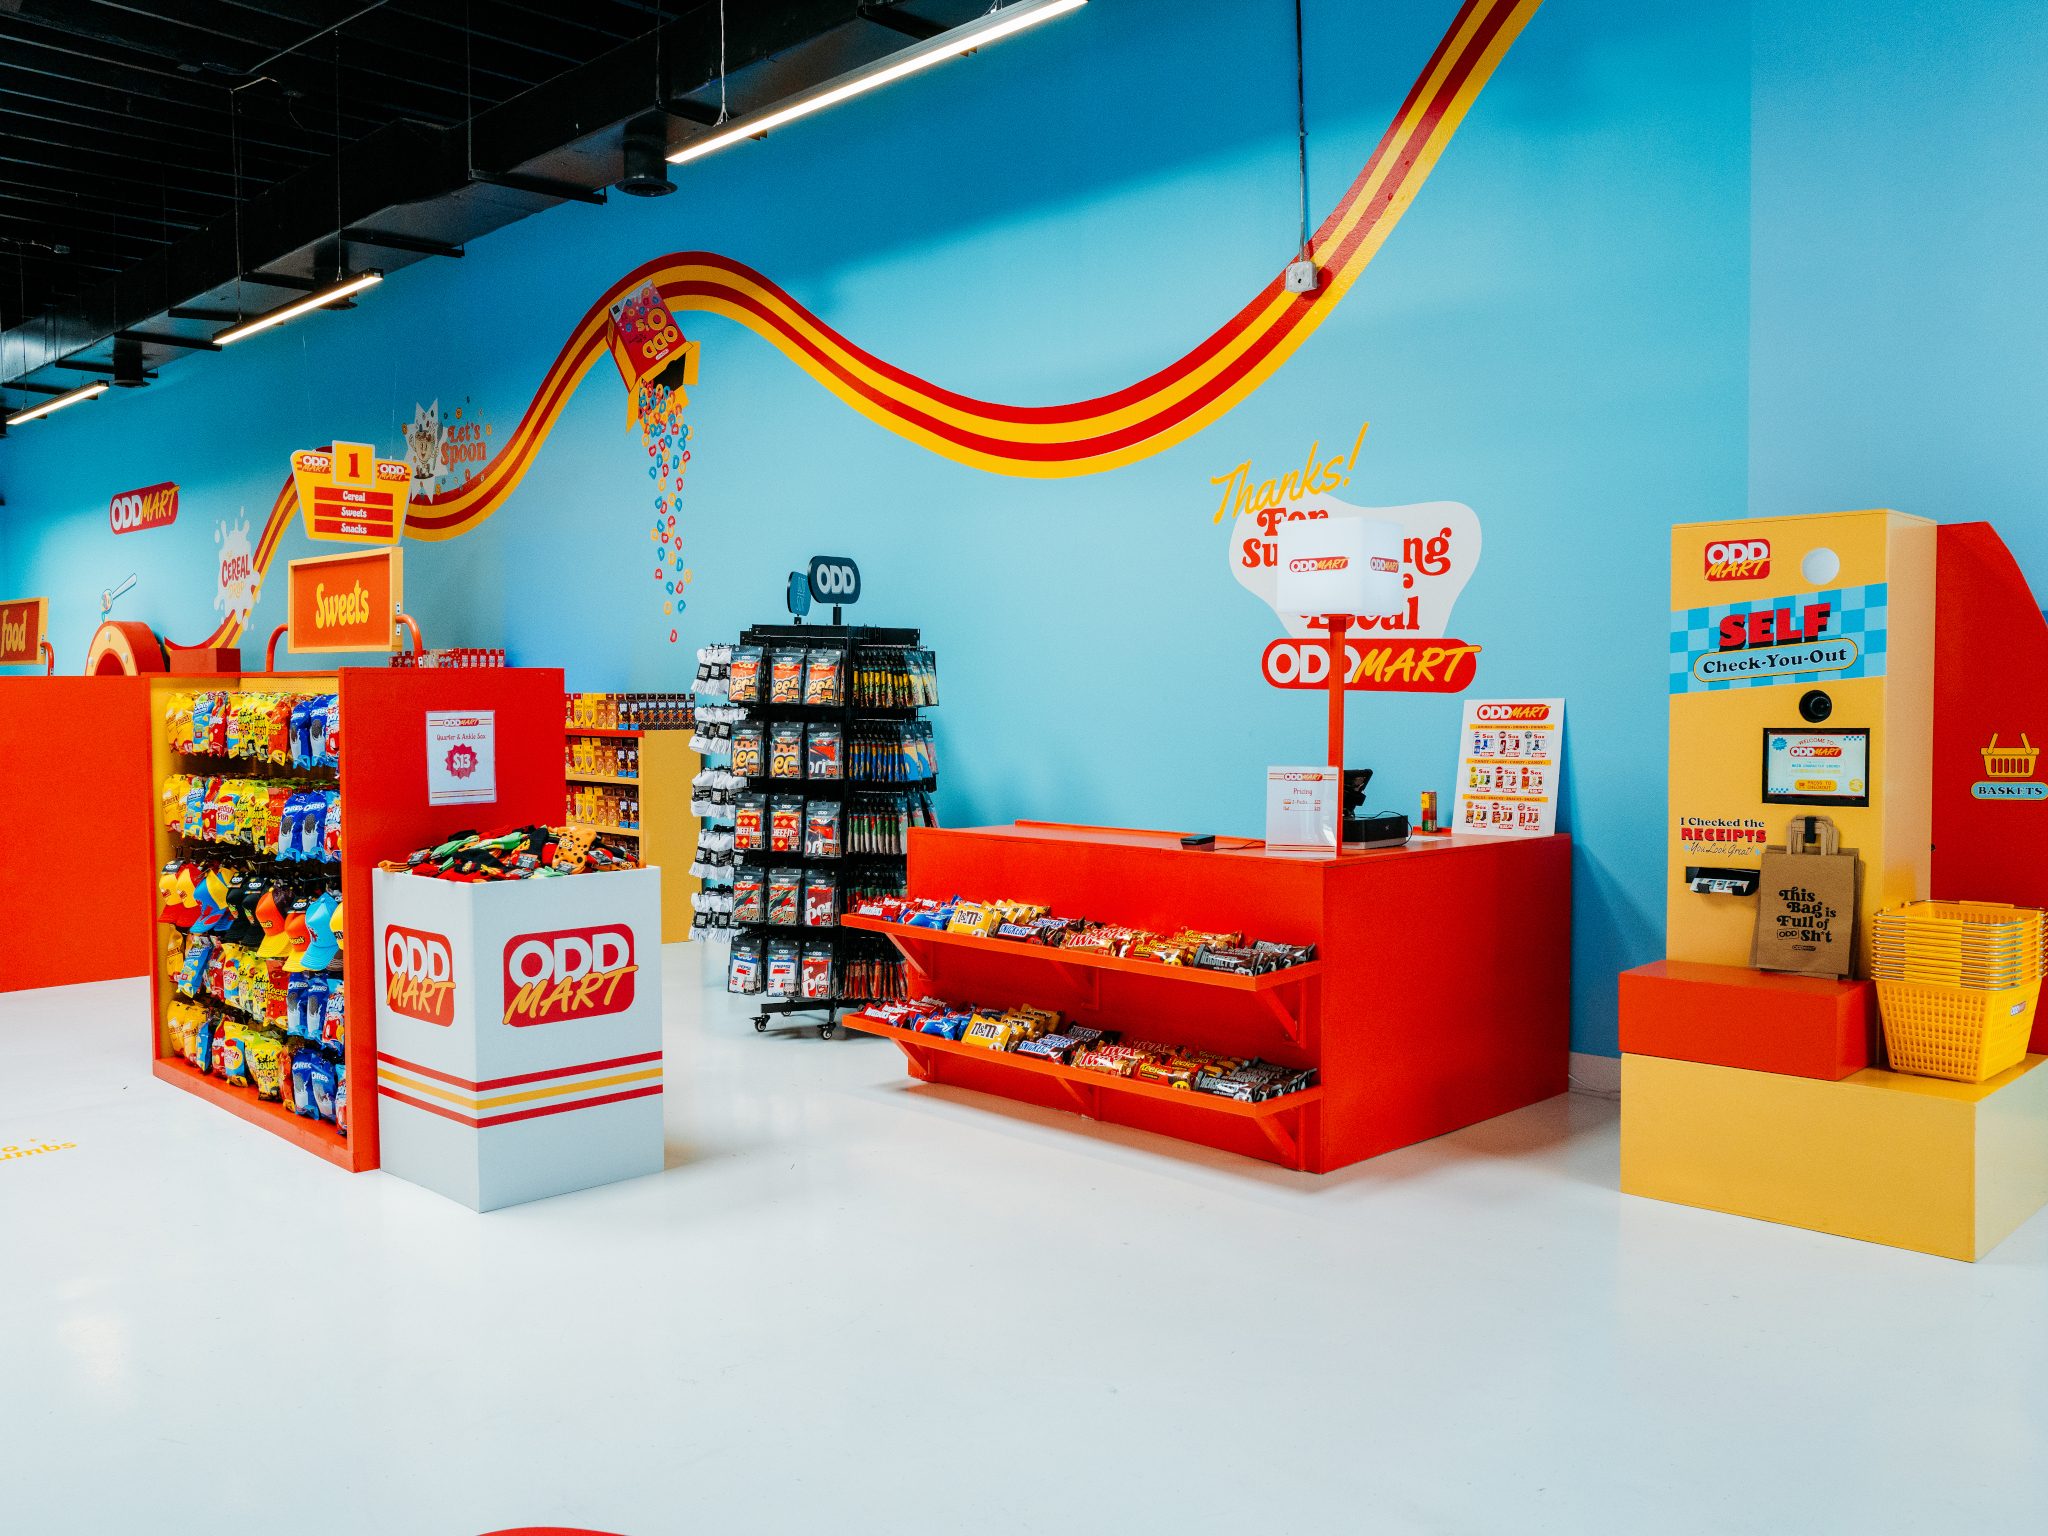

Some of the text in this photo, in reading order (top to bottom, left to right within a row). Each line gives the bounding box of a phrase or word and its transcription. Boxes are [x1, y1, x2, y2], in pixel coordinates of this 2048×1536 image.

[642, 326, 678, 358] ODD
[448, 422, 480, 443] Let's
[302, 456, 328, 466] ODD
[348, 453, 360, 478] 1
[441, 442, 486, 472] Spoon
[380, 464, 405, 474] ODD
[1210, 422, 1369, 524] Thanks!
[343, 491, 365, 501] Cereal
[112, 485, 180, 531] ODDMART
[341, 507, 367, 518] Sweets
[341, 523, 367, 534] Snacks
[1707, 541, 1769, 565] ODD
[222, 554, 250, 588] CEREAL
[1290, 558, 1350, 572] ODDMART
[1372, 558, 1399, 572] ODDMART
[1704, 558, 1772, 580] MART
[816, 564, 855, 594] ODD
[316, 580, 369, 629] Sweets
[1, 609, 27, 658] food
[1718, 602, 1831, 652] SELF
[1703, 648, 1847, 674] Check-You-Out
[1479, 706, 1551, 719] ODDMART
[1791, 747, 1843, 756] ODDMART
[453, 753, 470, 770] $13
[1294, 788, 1312, 796] Pricing
[1978, 786, 2042, 795] BASKETS
[303, 803, 325, 812] OREO
[1680, 817, 1764, 828] I Checked the
[1681, 828, 1767, 843] RECEIPTS
[1691, 842, 1706, 855] You
[1706, 843, 1727, 854] Look
[1779, 887, 1816, 902] This
[1786, 902, 1836, 918] Bag is
[1777, 915, 1829, 930] Full of
[387, 932, 450, 983] ODD
[508, 932, 630, 988] ODD
[386, 970, 456, 1016] MART
[502, 965, 639, 1025] MART
